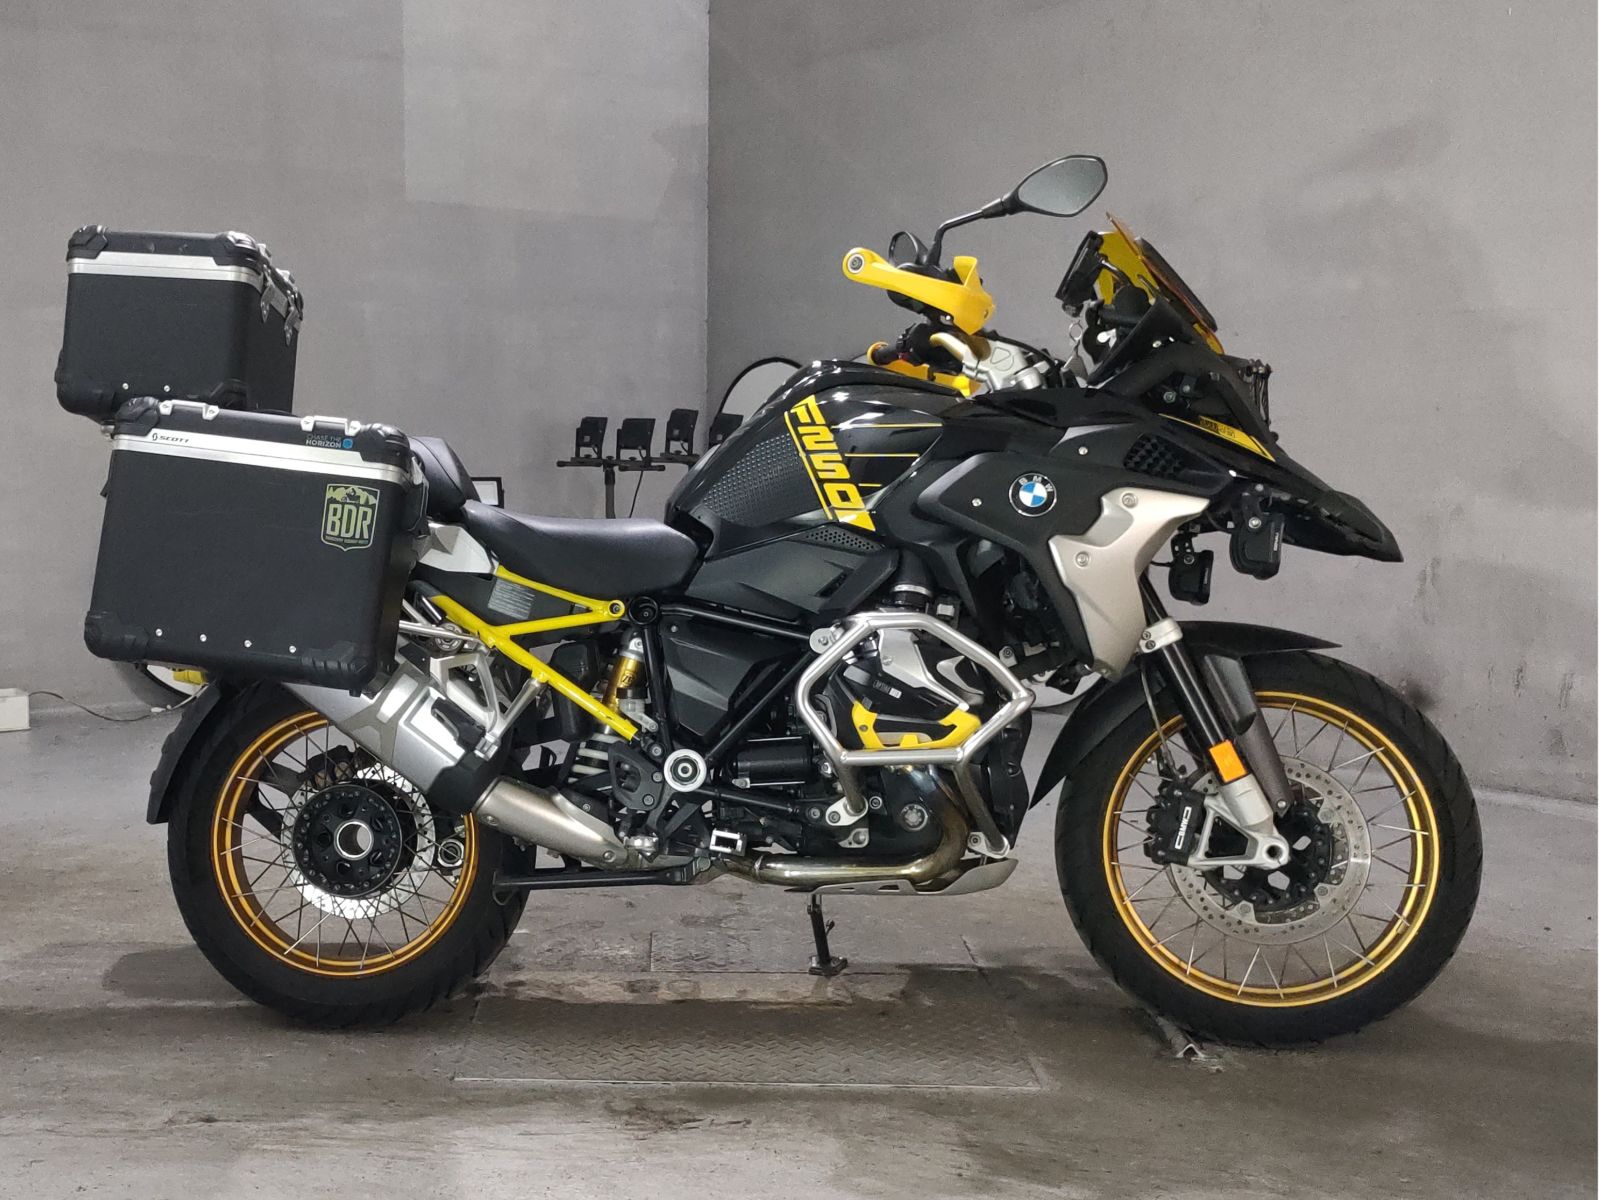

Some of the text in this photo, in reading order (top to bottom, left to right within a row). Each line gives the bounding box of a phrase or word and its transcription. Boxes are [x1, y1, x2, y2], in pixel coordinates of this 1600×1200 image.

[160, 435, 189, 443] SCOTT
[305, 439, 342, 448] HORIZON
[1018, 475, 1054, 492] BMW
[326, 503, 373, 539] BDR
